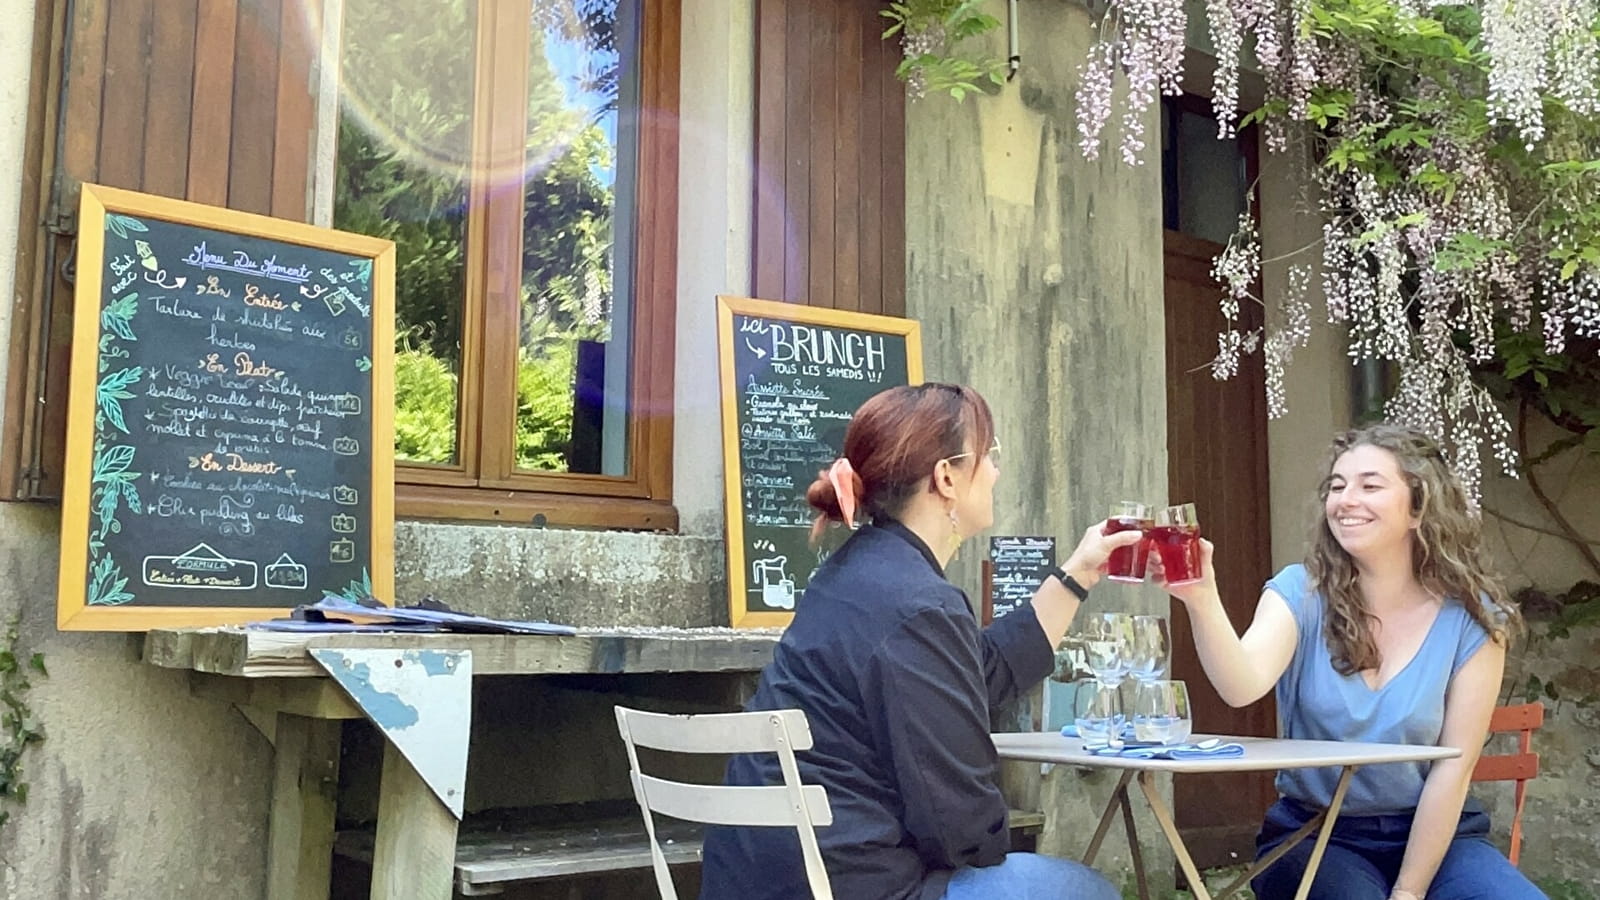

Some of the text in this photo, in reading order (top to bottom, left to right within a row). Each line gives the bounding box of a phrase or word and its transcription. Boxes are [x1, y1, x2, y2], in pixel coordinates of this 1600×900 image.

[184, 241, 312, 278] Menu Du Moment
[206, 275, 288, 310] En Entrée
[212, 307, 226, 322] de
[302, 326, 326, 339] aux
[740, 316, 769, 335] ici
[205, 324, 256, 350] herbes
[770, 324, 885, 370] BRUNCH
[206, 353, 229, 373] En
[771, 363, 797, 375] TOUS
[803, 365, 820, 376] LES
[826, 368, 863, 380] SAMEDIS
[195, 424, 206, 437] et
[201, 453, 281, 474] En Dessert
[200, 499, 252, 527] pudding
[176, 560, 227, 571] FORMULE
